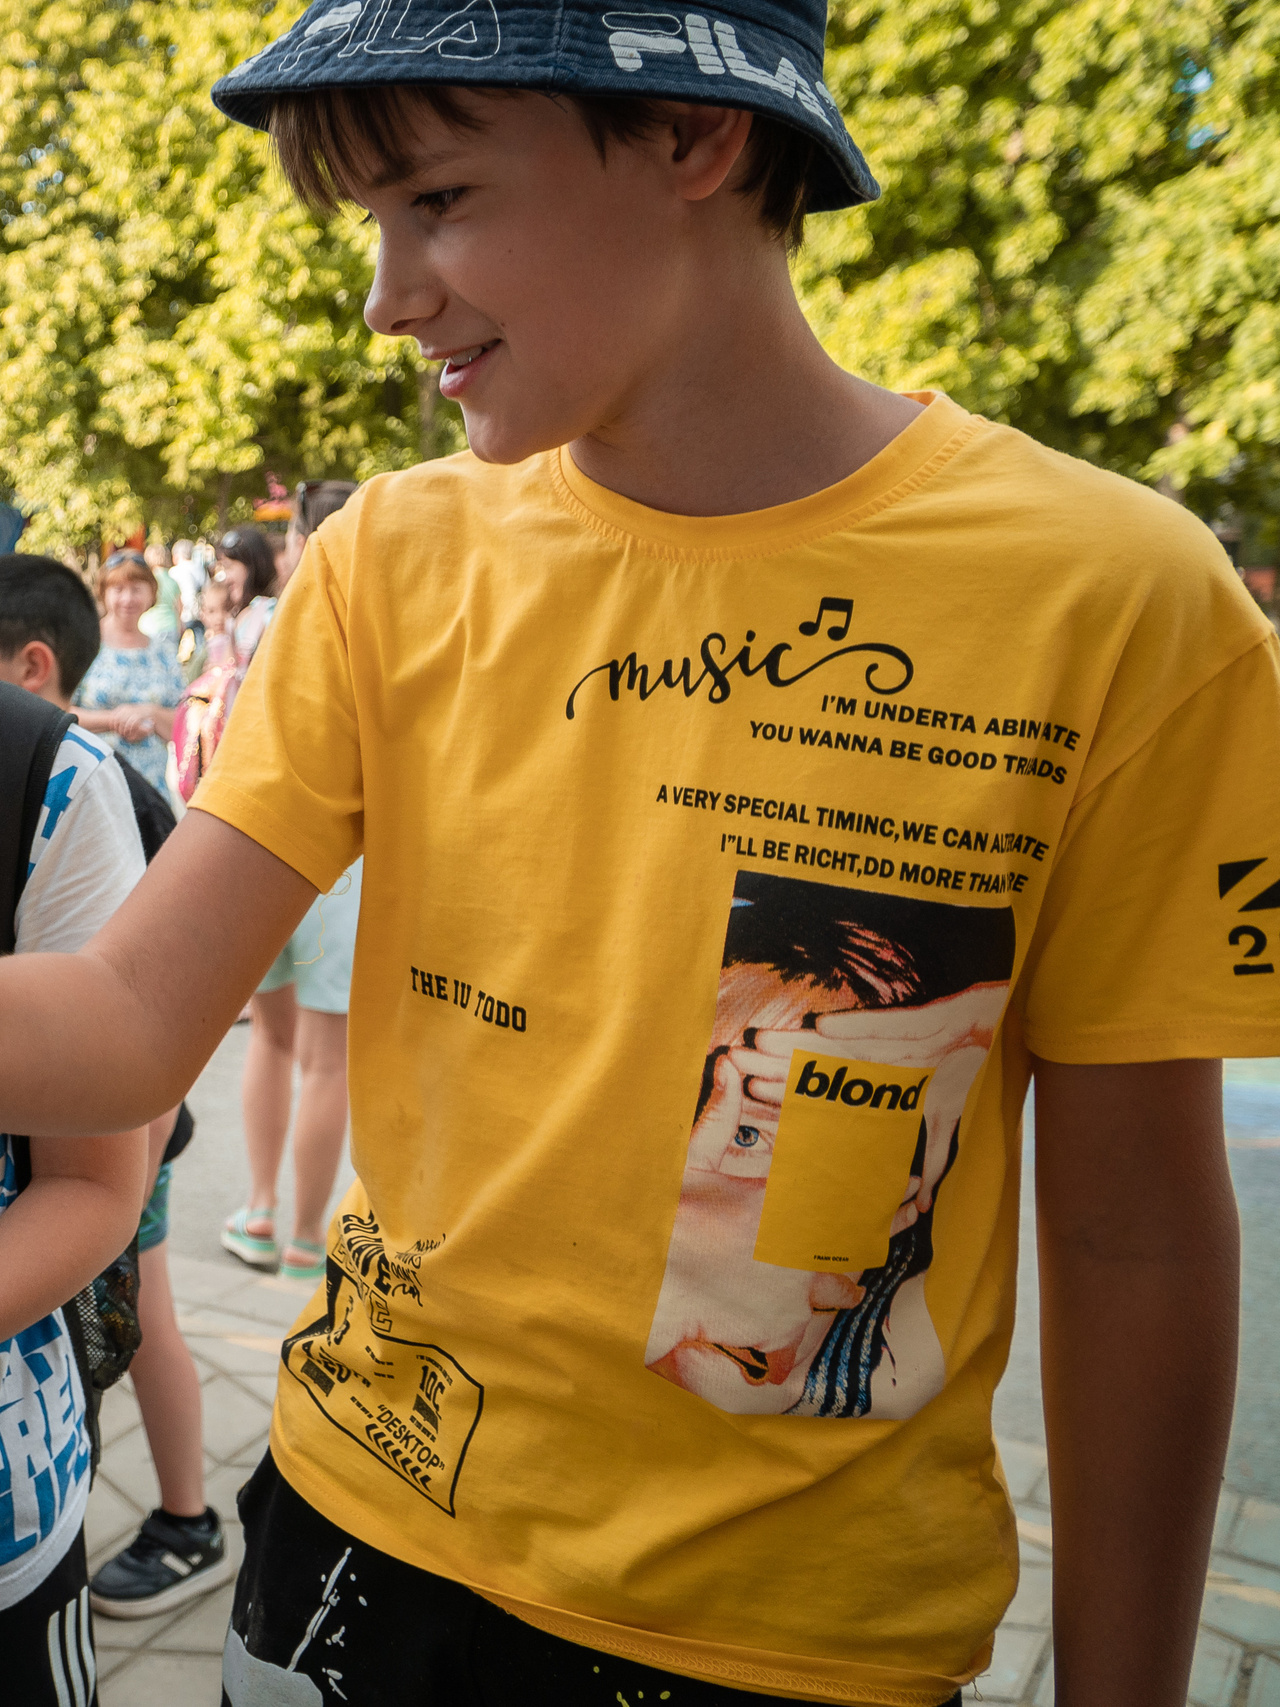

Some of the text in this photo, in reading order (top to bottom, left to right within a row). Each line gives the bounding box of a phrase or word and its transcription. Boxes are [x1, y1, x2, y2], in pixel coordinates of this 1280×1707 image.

[566, 629, 914, 720] music
[821, 694, 857, 716] I'M
[863, 700, 977, 734] UNDERTA
[749, 720, 794, 743] YOU
[799, 727, 883, 756] WANNA
[889, 739, 923, 762] BE
[927, 746, 997, 771] GOOD
[656, 784, 668, 803] A
[673, 786, 722, 811] VERY
[723, 794, 811, 824] SPECIAL
[942, 827, 989, 853] CAN
[762, 839, 791, 862] BE
[899, 862, 966, 891] MORE
[410, 965, 449, 1001] THE
[474, 990, 527, 1033] TODO
[794, 1060, 930, 1112] blond
